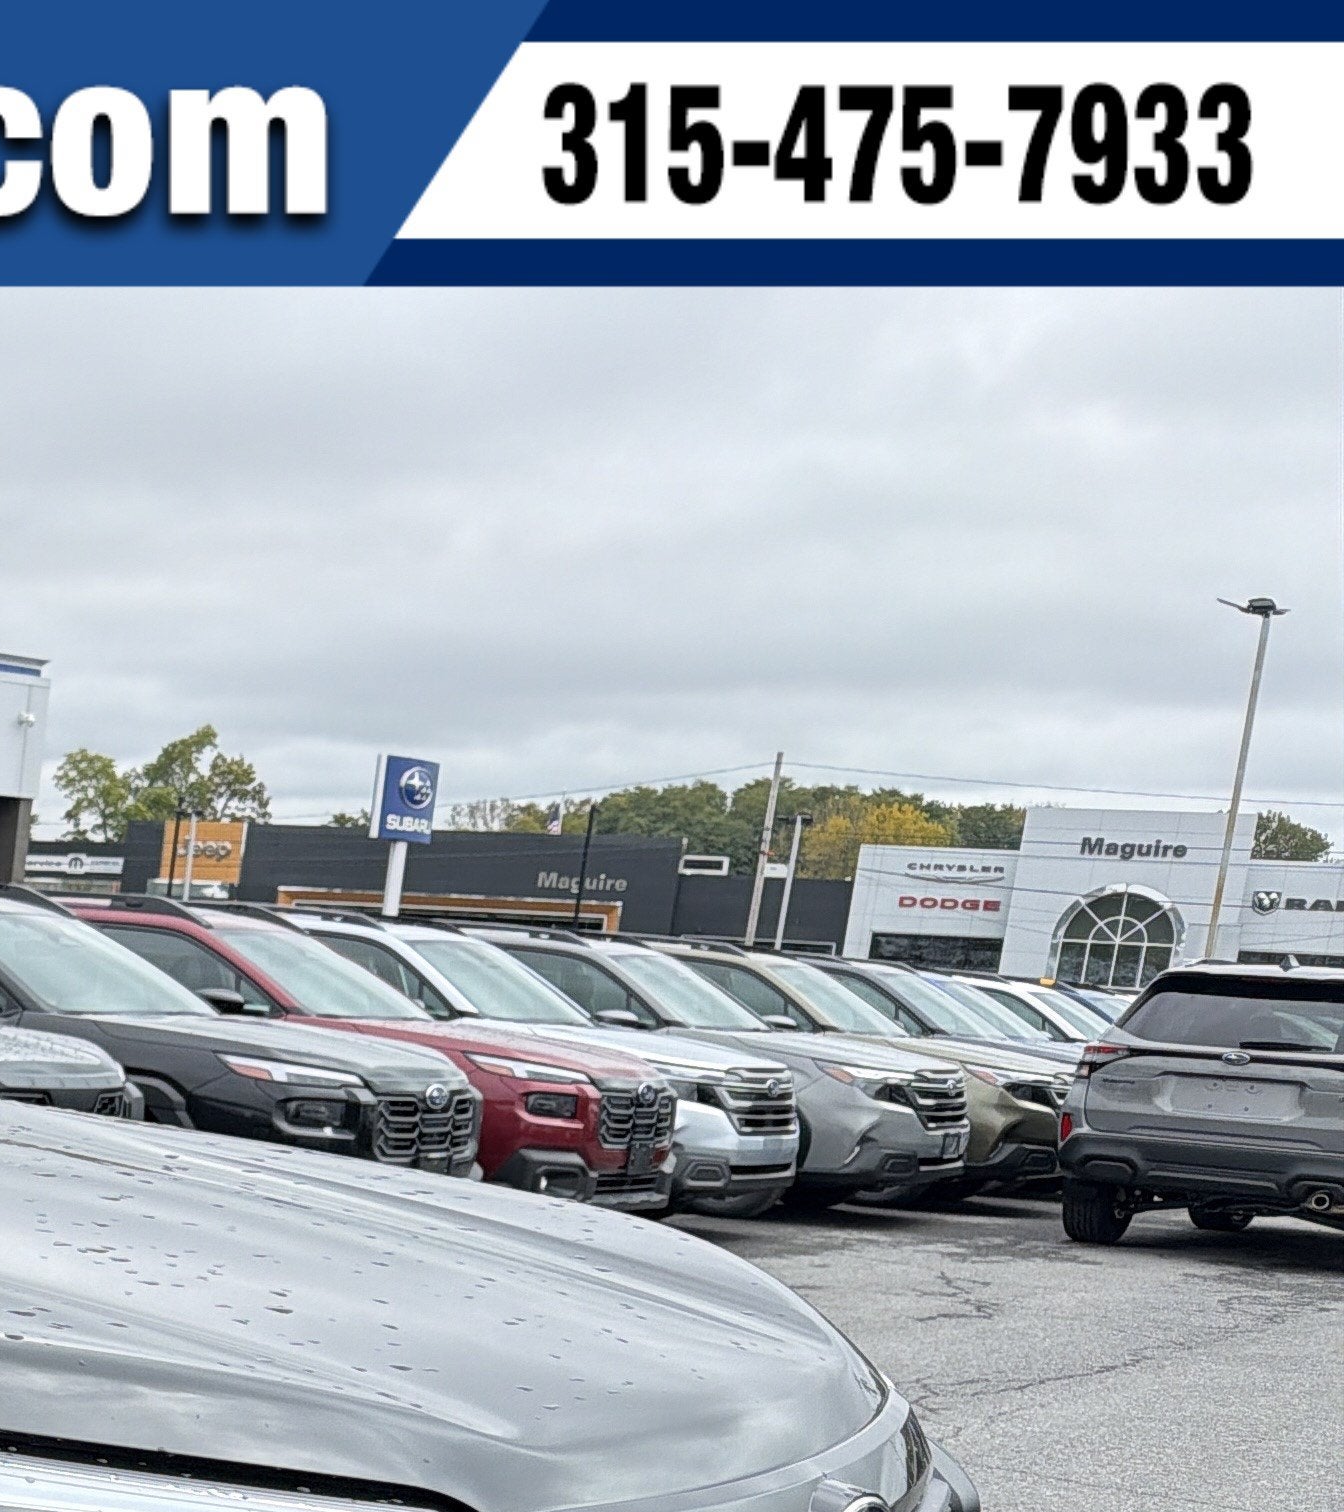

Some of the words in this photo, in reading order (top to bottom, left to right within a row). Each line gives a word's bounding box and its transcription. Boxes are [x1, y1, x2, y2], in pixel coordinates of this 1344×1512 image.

[385, 813, 432, 835] SUBARU
[177, 836, 231, 862] Jeep
[1080, 837, 1188, 861] Maguire
[907, 862, 1004, 874] CHRYSLER
[537, 871, 628, 894] Maguire
[899, 896, 1001, 912] DODGE
